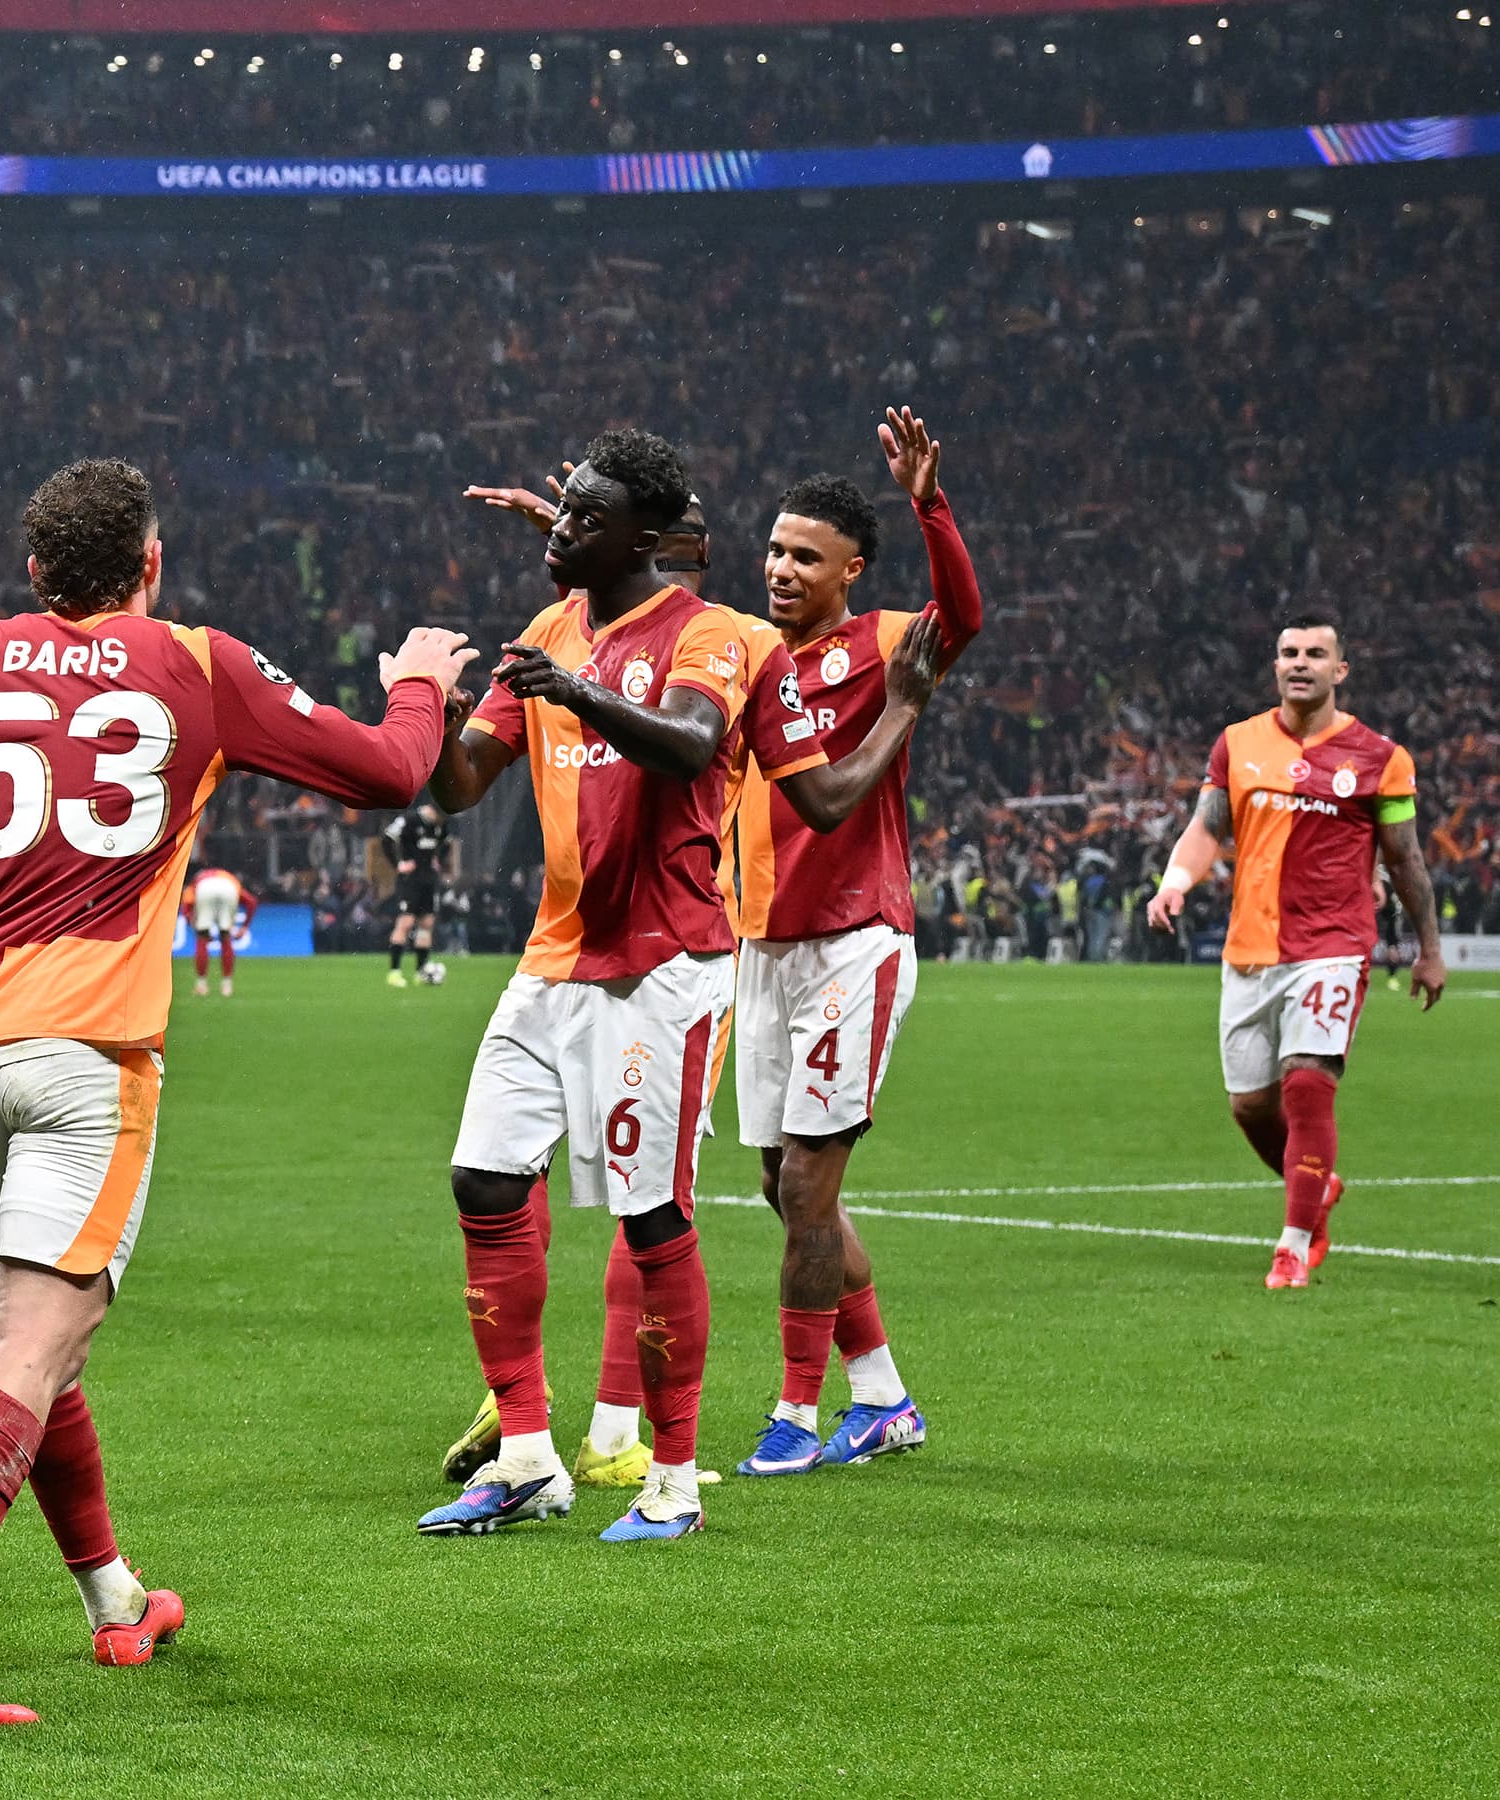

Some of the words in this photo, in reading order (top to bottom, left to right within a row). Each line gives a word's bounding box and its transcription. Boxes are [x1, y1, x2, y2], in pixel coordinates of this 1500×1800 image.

[157, 164, 223, 188] UEFA
[227, 164, 381, 188] CHAMPIONS
[386, 164, 486, 188] LEAGUE
[3, 637, 128, 679] BARIŞ
[1302, 981, 1352, 1023] 42
[806, 1028, 842, 1082] 4
[606, 1097, 642, 1157] 6
[643, 1313, 668, 1327] GS
